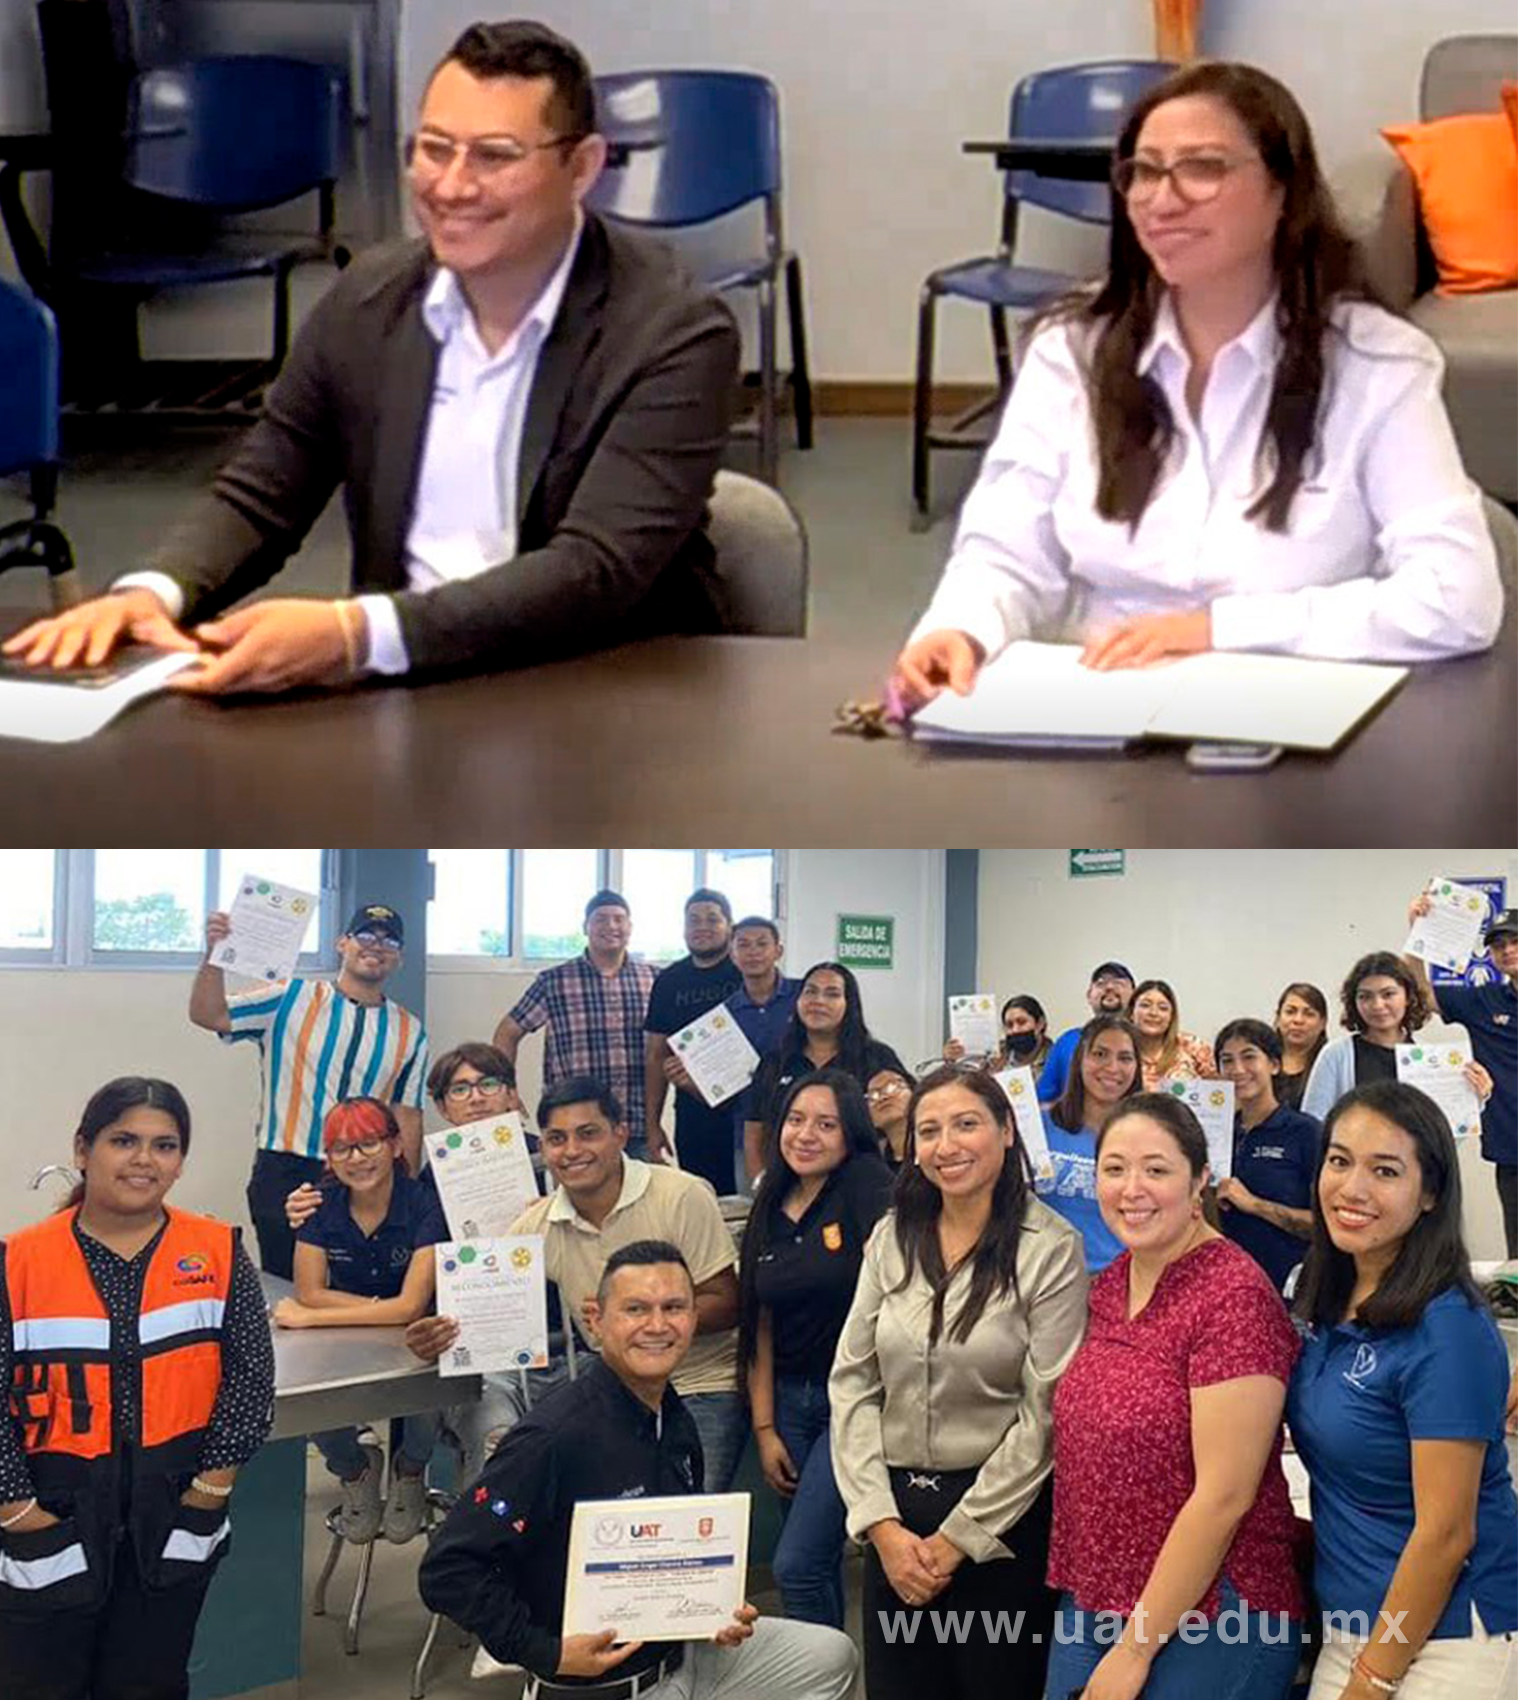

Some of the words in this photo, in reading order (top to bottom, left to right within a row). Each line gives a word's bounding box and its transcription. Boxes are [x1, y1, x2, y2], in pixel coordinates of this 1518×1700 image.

[844, 924, 873, 940] SALIDA
[875, 925, 887, 941] DE
[838, 943, 890, 959] EMERGENCIA
[630, 1523, 663, 1539] UAT
